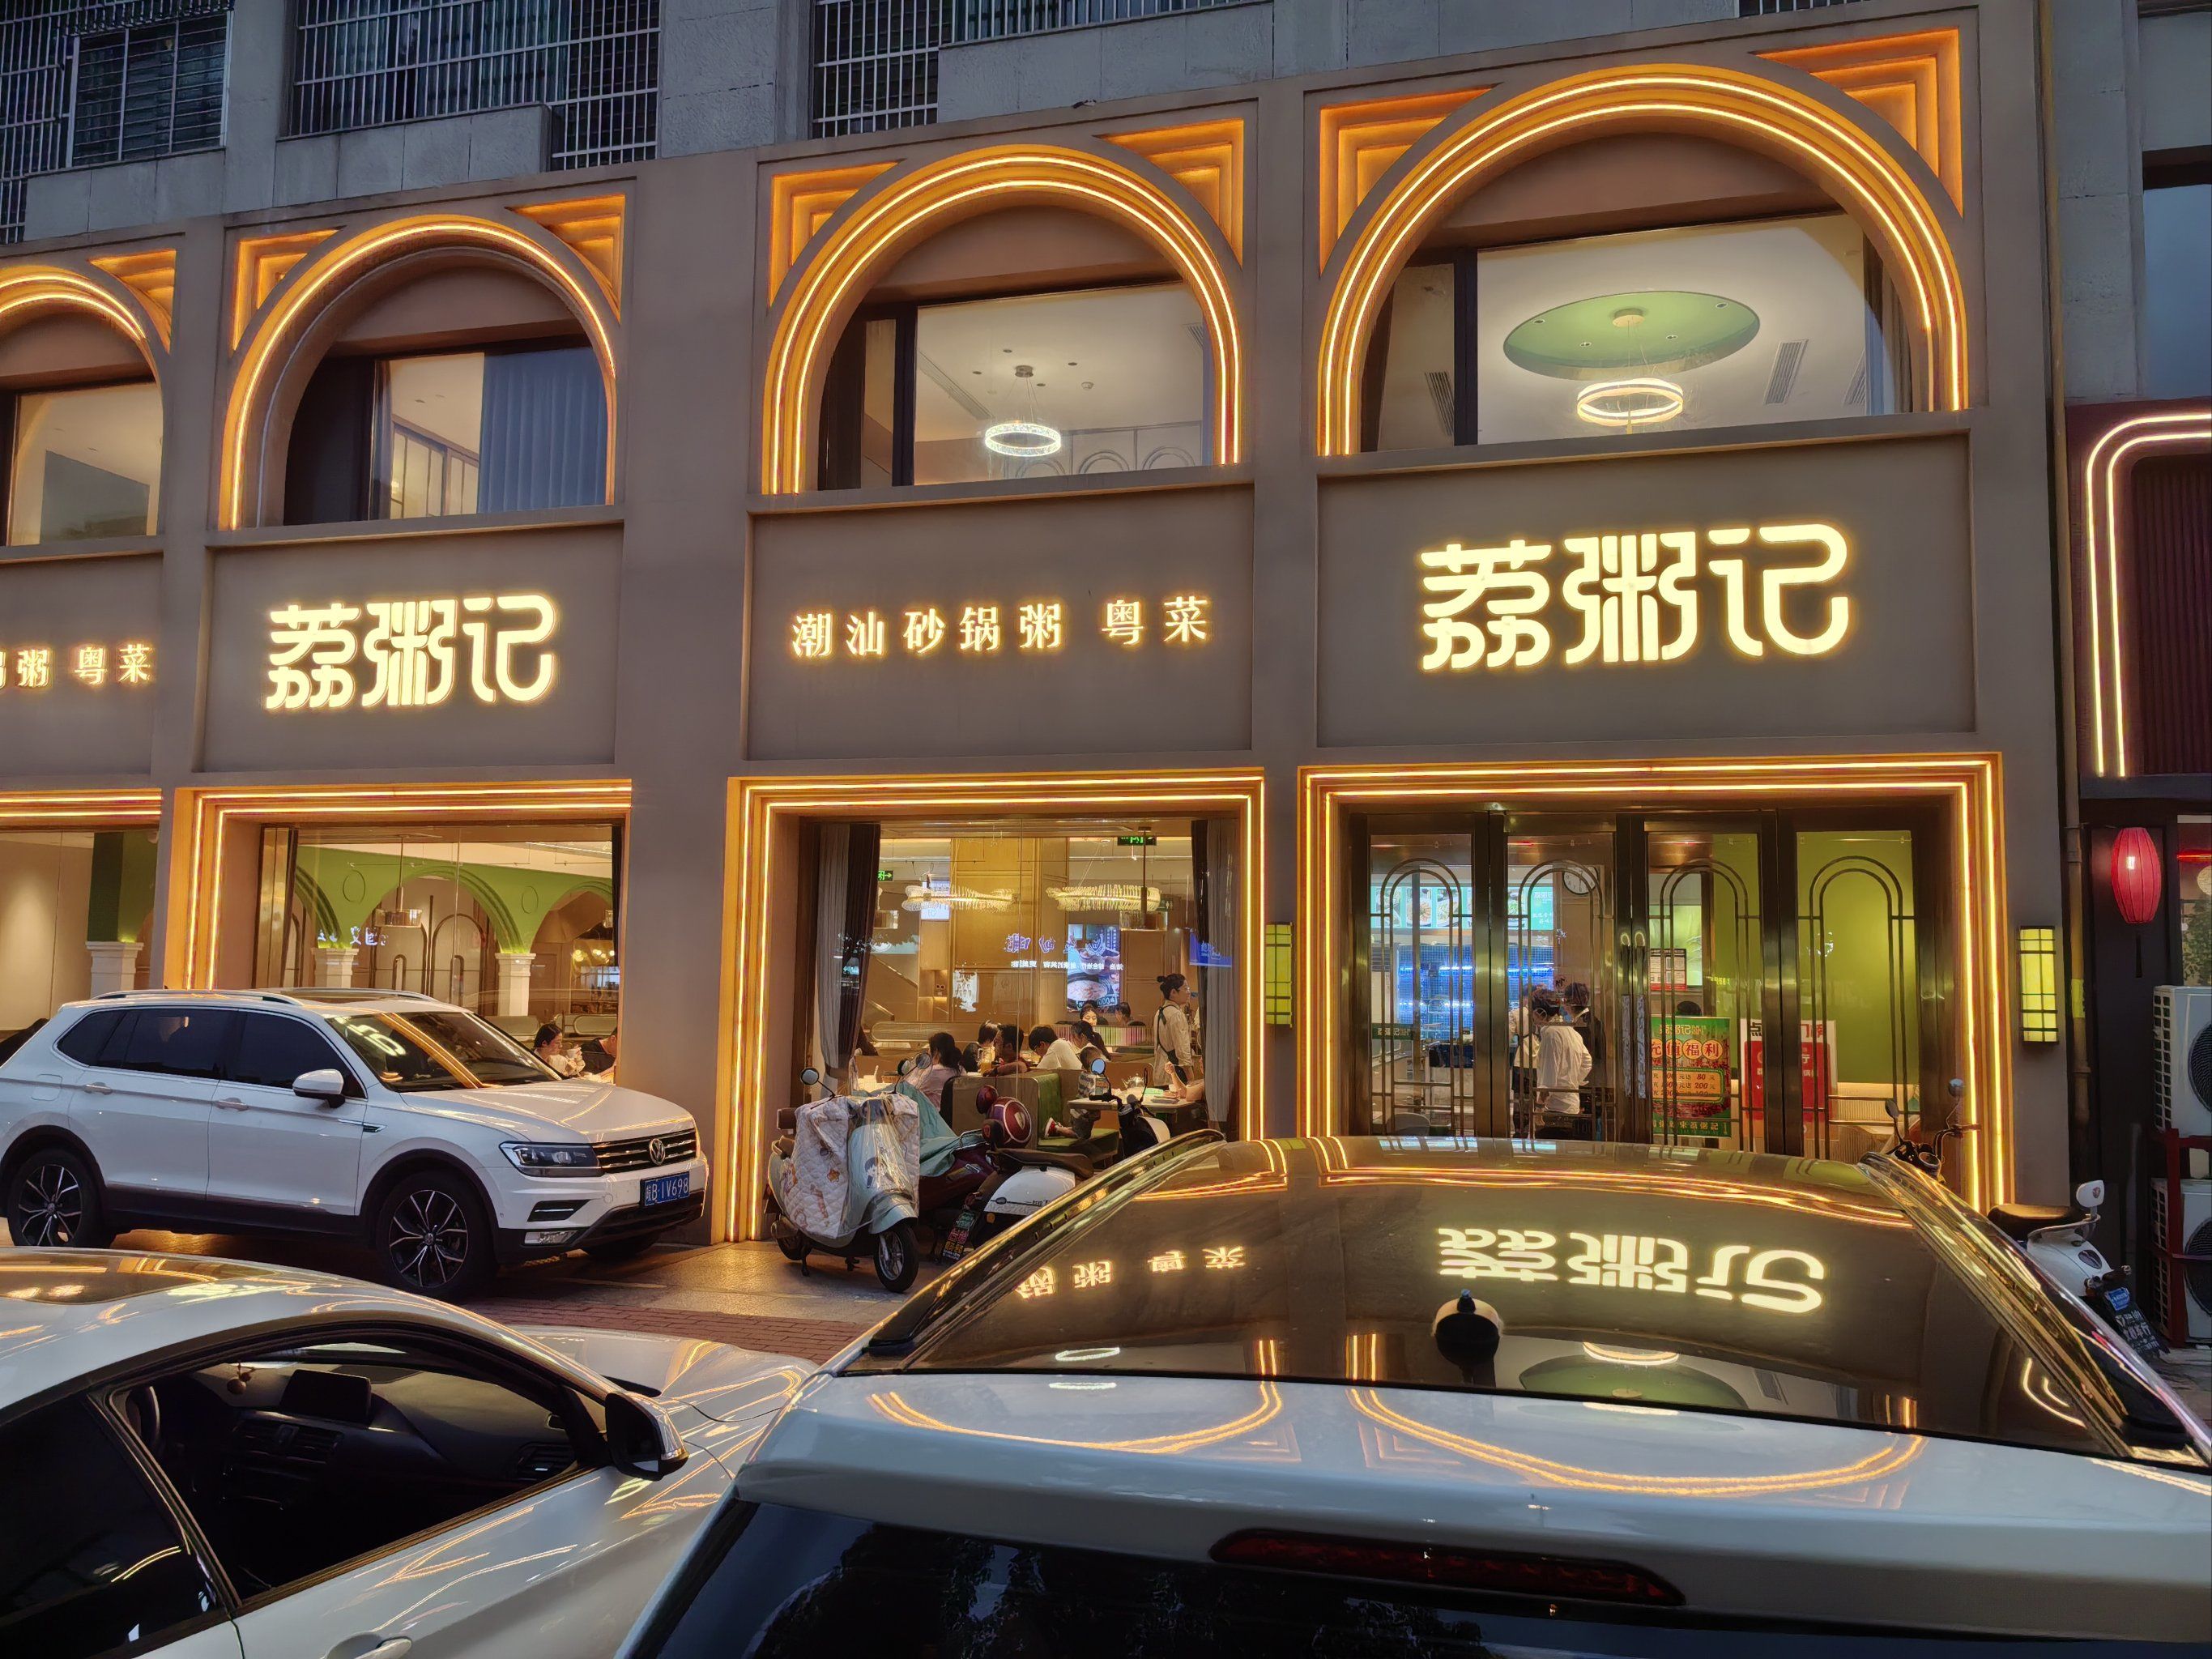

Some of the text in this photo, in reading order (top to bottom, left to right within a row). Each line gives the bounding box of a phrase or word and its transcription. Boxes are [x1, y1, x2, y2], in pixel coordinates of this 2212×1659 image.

[792, 596, 1207, 657] 潮汕砂锅粥 粤菜
[1421, 523, 1848, 670] 荔粥记
[0, 644, 151, 689] 粥 粤菜
[266, 595, 556, 710] 荔粥记
